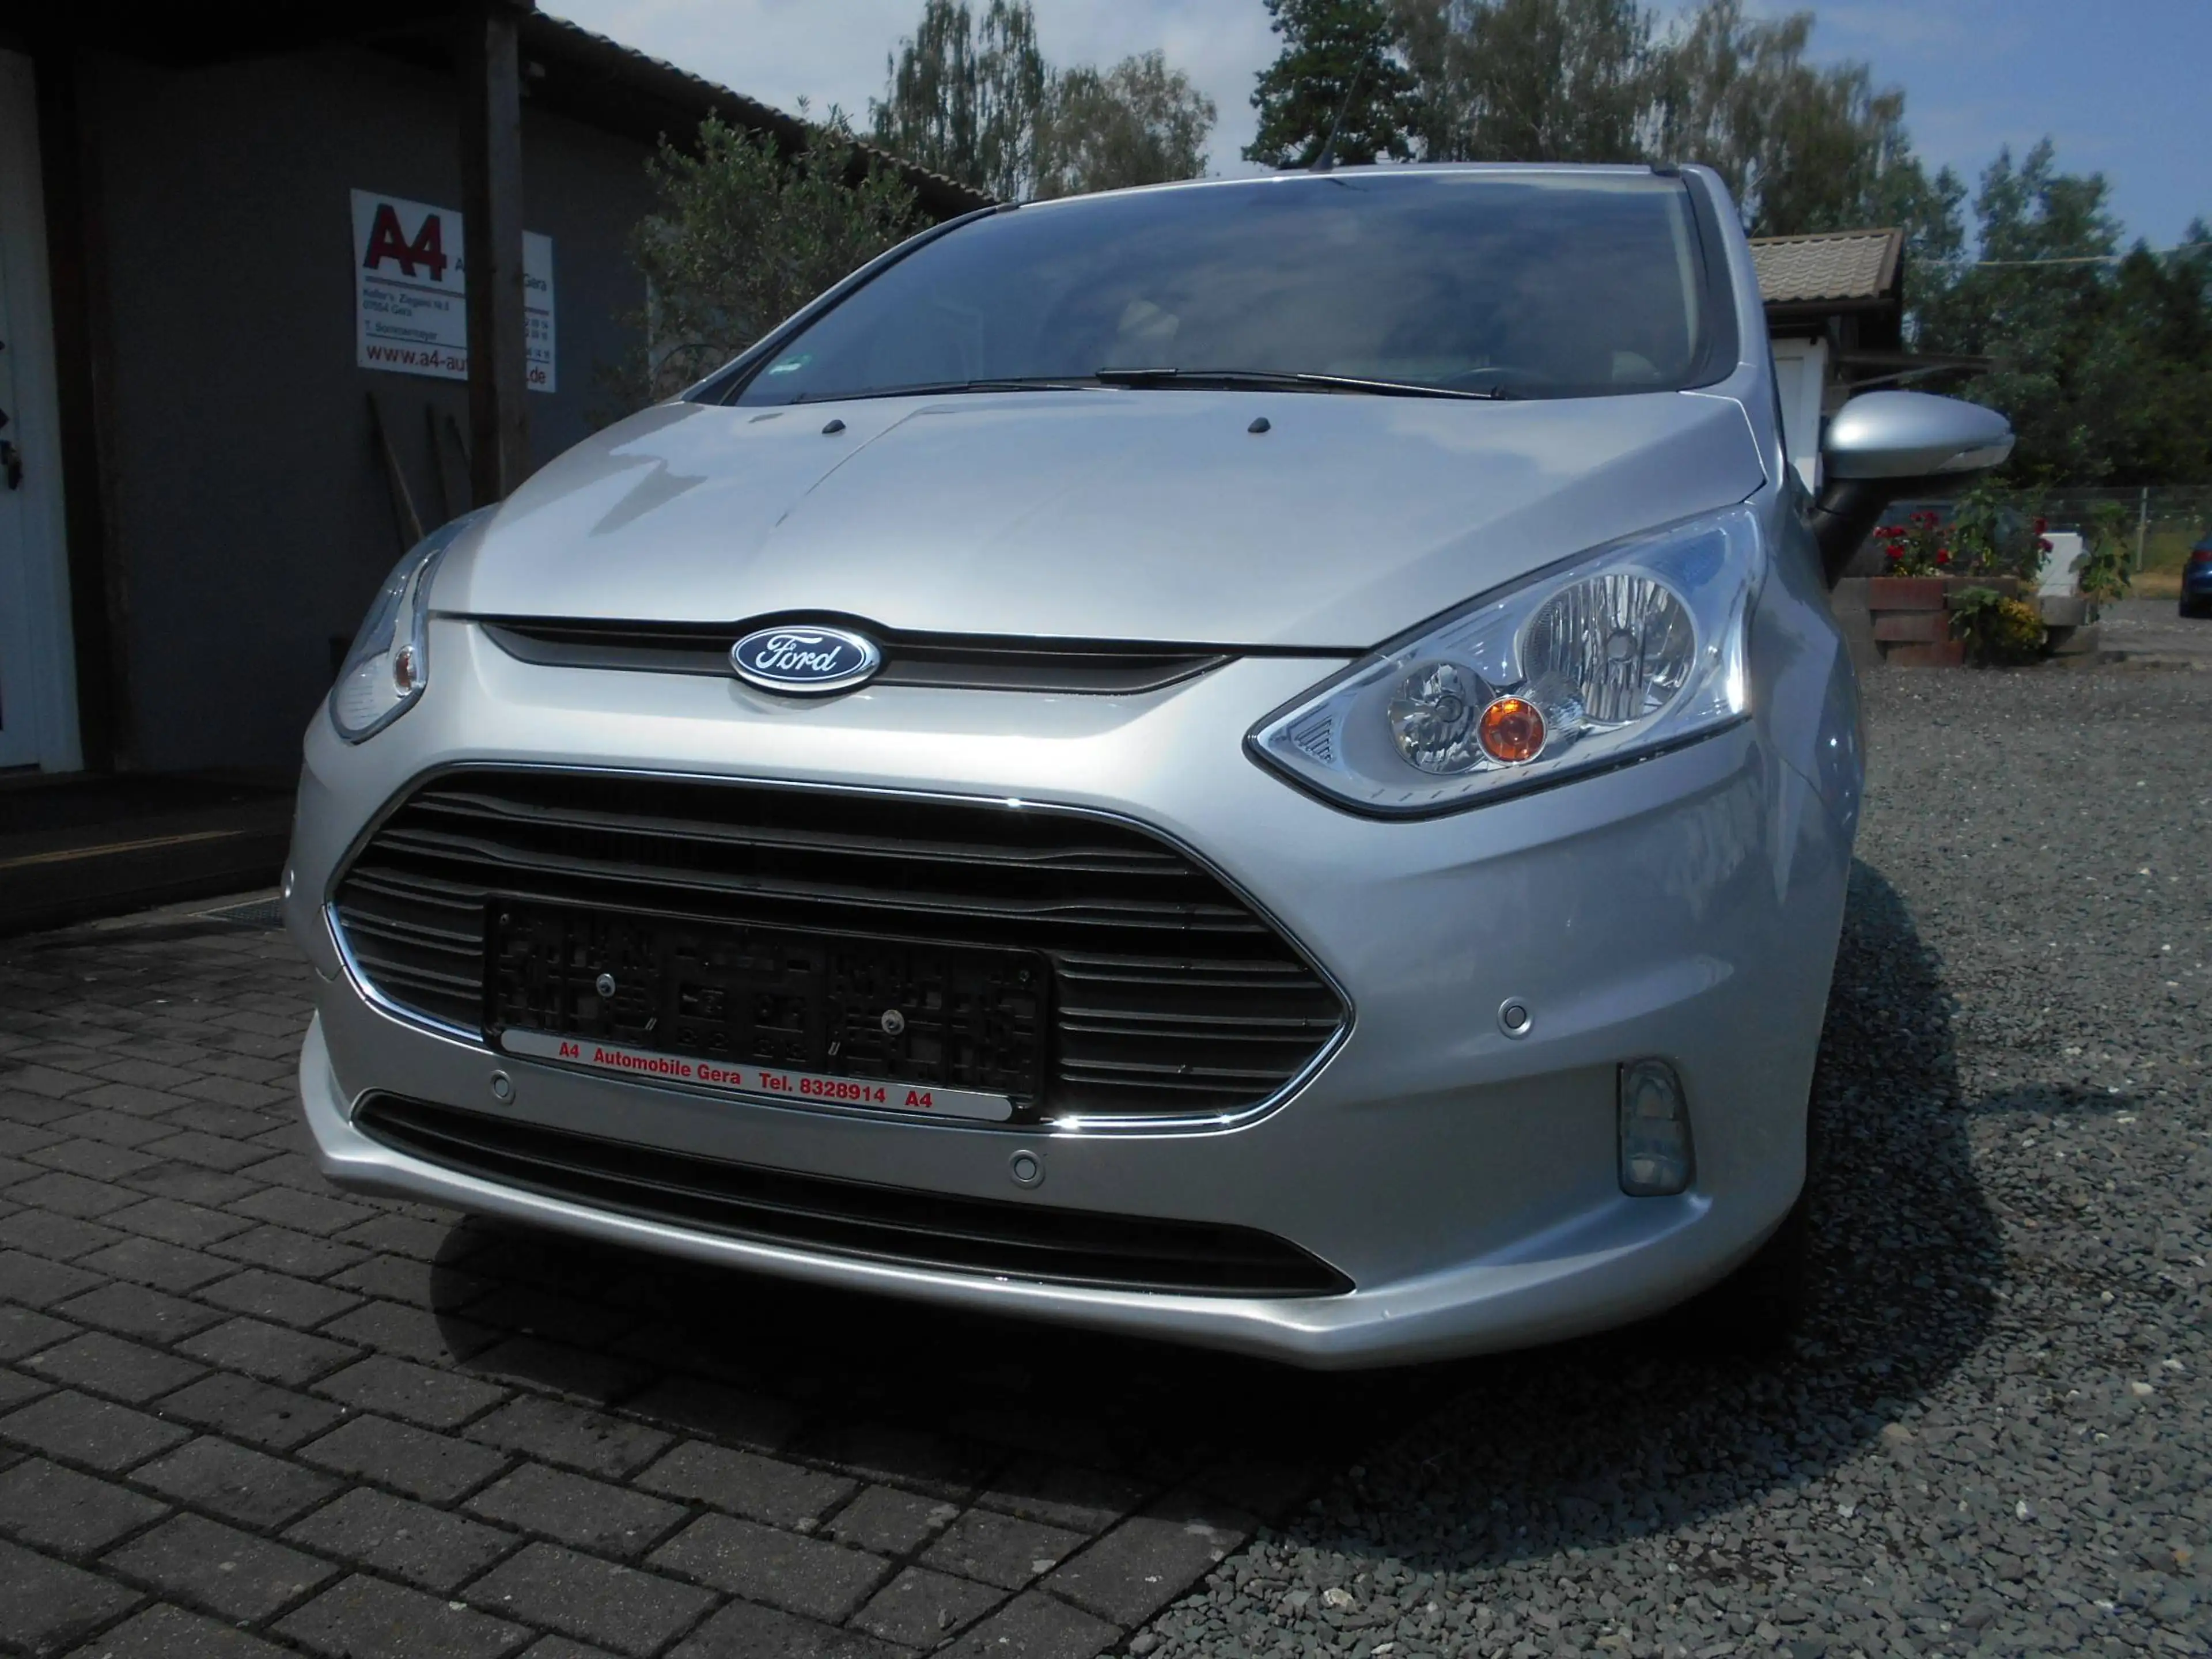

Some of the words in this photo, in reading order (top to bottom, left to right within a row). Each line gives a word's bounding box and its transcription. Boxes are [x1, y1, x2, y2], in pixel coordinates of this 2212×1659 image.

[363, 203, 447, 282] A4
[756, 635, 842, 671] Ford
[559, 1041, 579, 1058] A4
[593, 1047, 692, 1077] Automobile
[697, 1064, 741, 1085] Gera
[759, 1067, 793, 1092] Tel.
[800, 1078, 886, 1103] 8328914
[905, 1090, 932, 1108] A4
